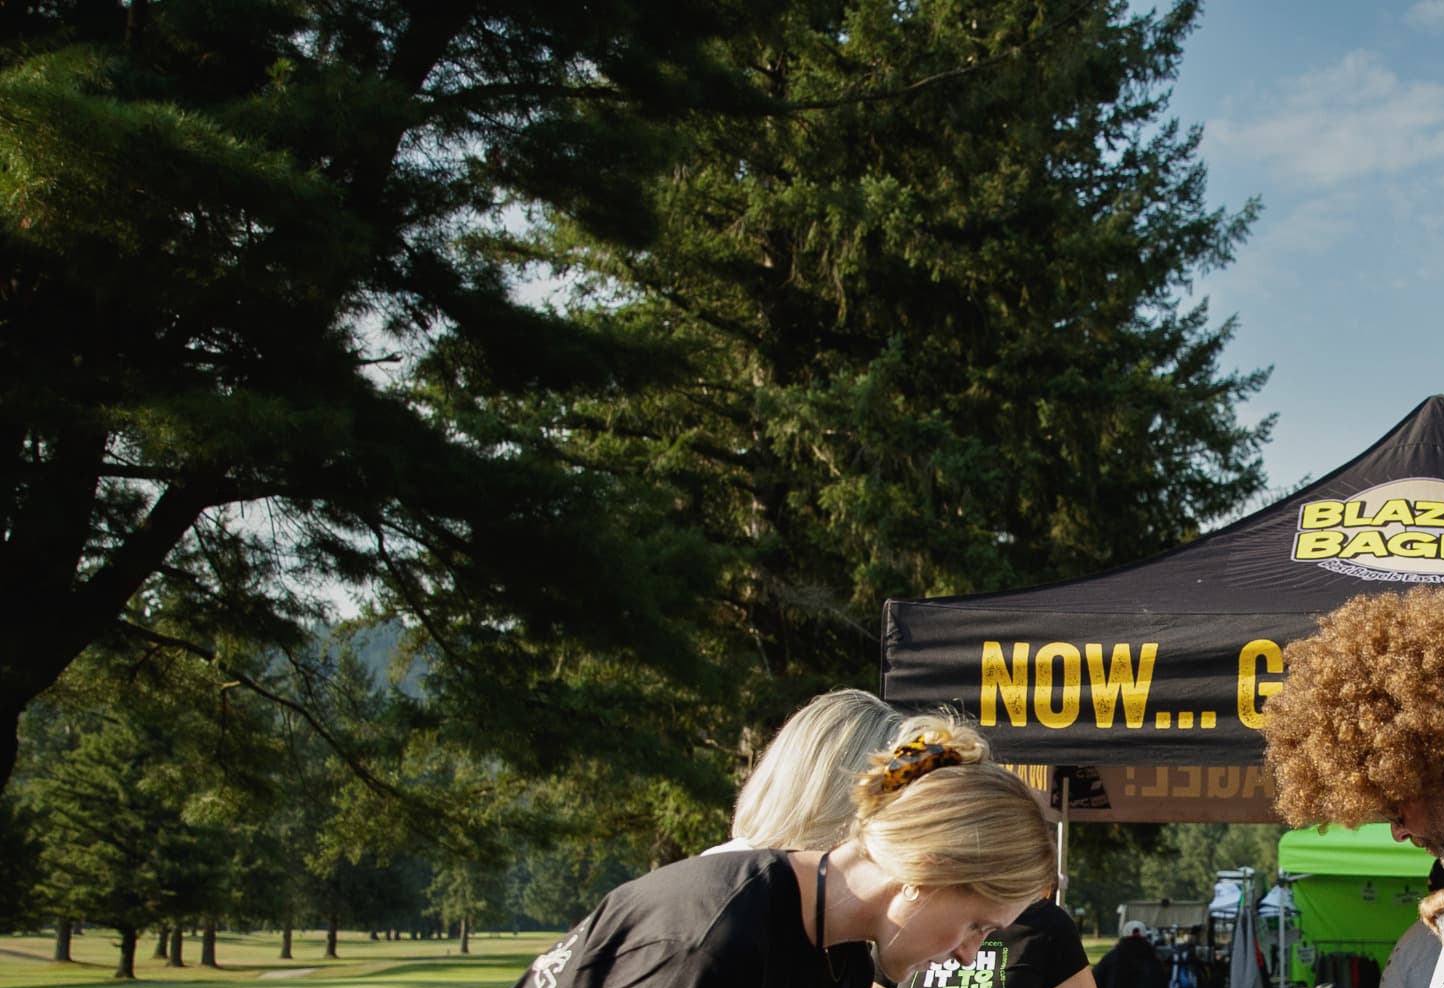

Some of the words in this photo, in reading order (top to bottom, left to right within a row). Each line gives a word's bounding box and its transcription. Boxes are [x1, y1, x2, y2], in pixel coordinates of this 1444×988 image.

[979, 640, 1216, 730] NOW...
[923, 969, 953, 987] IT
[958, 969, 994, 985] TO
